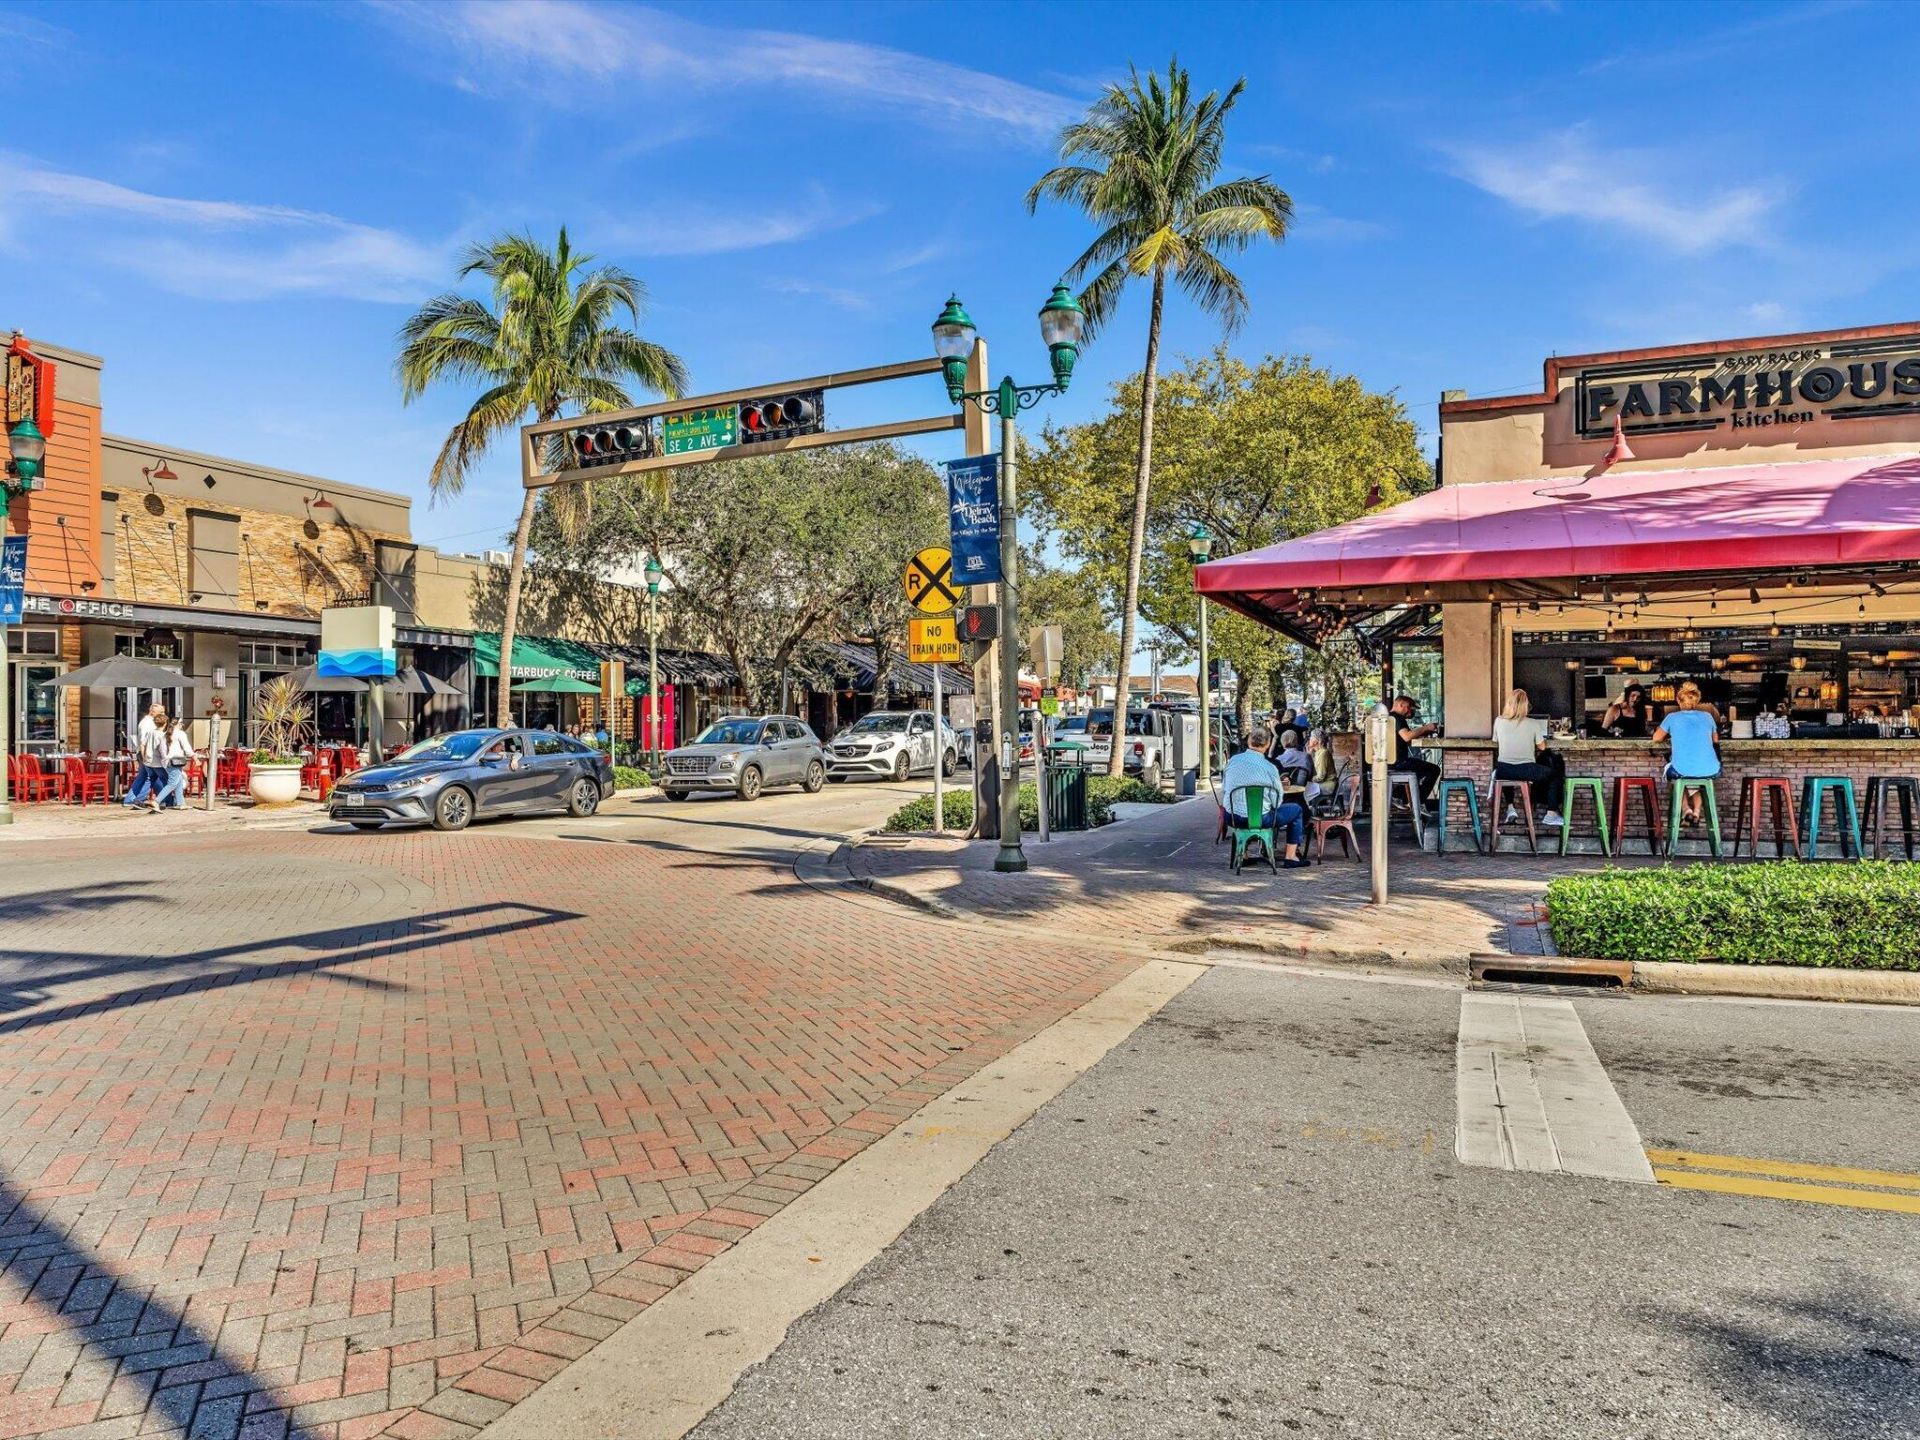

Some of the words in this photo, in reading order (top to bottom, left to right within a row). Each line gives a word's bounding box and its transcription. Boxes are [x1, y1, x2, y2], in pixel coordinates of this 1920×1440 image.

[1724, 354, 1764, 369] GARY
[1769, 349, 1822, 364] RACK'S
[683, 413, 694, 425] NE
[701, 411, 708, 424] 2
[715, 407, 732, 421] AVE
[1731, 409, 1814, 430] kitchen
[669, 440, 680, 453] SE
[687, 438, 694, 450] 2
[700, 433, 718, 448] AVE
[953, 473, 992, 493] Welcome
[965, 504, 995, 518] Delray
[971, 514, 997, 525] Beach
[909, 574, 921, 590] R
[25, 596, 51, 611] HE
[59, 598, 134, 618] OFFICE
[926, 625, 942, 637] NO
[912, 643, 934, 655] TRAIN
[936, 642, 957, 655] HORN
[510, 666, 561, 678] TARBUCKS
[564, 669, 597, 680] COFFEE
[646, 714, 668, 723] SLE
[1090, 743, 1109, 751] Jeep
